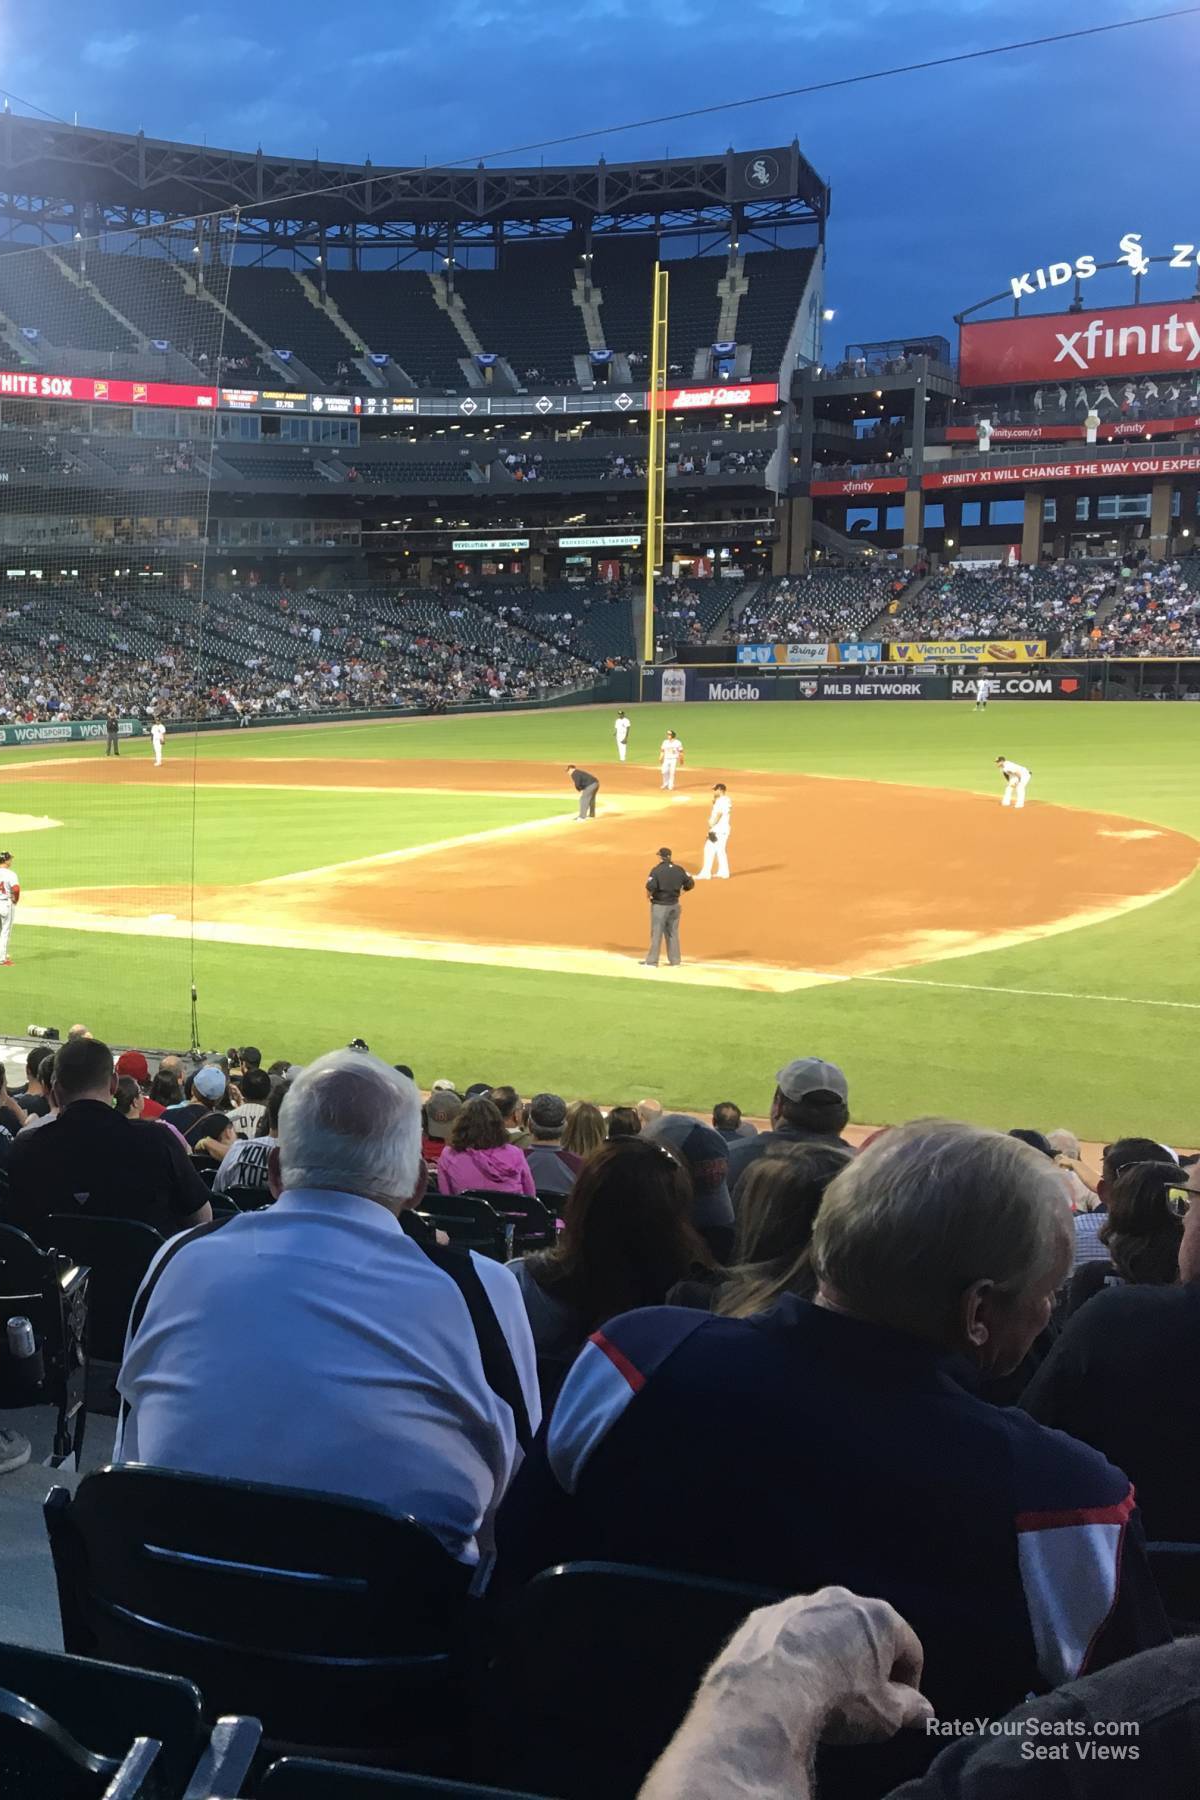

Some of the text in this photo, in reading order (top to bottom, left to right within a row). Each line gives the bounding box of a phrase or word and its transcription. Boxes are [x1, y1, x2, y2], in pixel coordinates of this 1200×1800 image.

[1010, 255, 1097, 299] KIDS
[41, 378, 72, 396] SOX
[1114, 423, 1145, 434] xfinity
[942, 473, 978, 485] XFINITY
[980, 471, 992, 482] X1
[994, 469, 1020, 480] WILL
[1022, 466, 1071, 479] CHANGE
[1074, 464, 1098, 475] THE
[1101, 462, 1128, 474] WAY
[1132, 461, 1159, 472] YOU
[842, 480, 874, 494] xfinity
[789, 645, 826, 657] Bring it
[915, 644, 956, 654] Vienna
[959, 644, 986, 654] Beef
[708, 683, 760, 700] Modelo
[824, 684, 851, 695] MLB
[855, 683, 921, 695] NETWORK
[952, 679, 1052, 694] RAE.COM
[15, 727, 72, 741] WGN SPORTS
[80, 725, 107, 737] WGN
